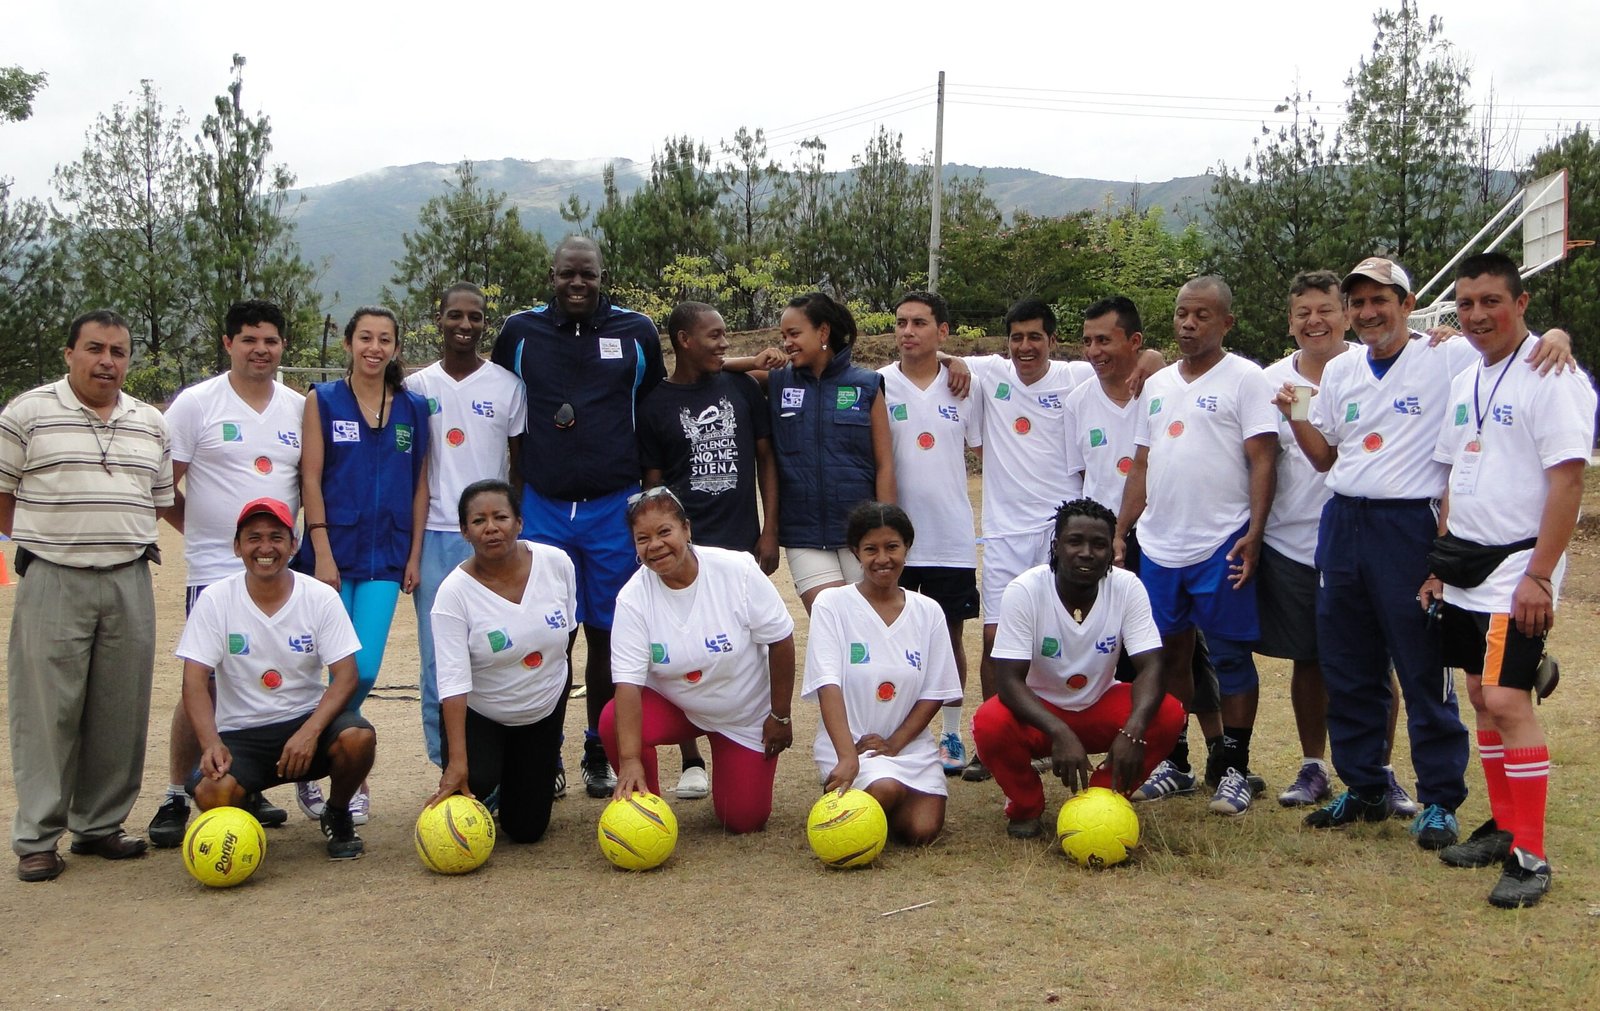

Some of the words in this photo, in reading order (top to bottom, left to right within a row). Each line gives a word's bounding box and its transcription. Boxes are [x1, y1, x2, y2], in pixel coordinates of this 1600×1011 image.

[705, 424, 716, 433] LA
[691, 438, 736, 453] VIOLENCIA
[718, 448, 733, 460] ME
[691, 461, 738, 476] SUENA
